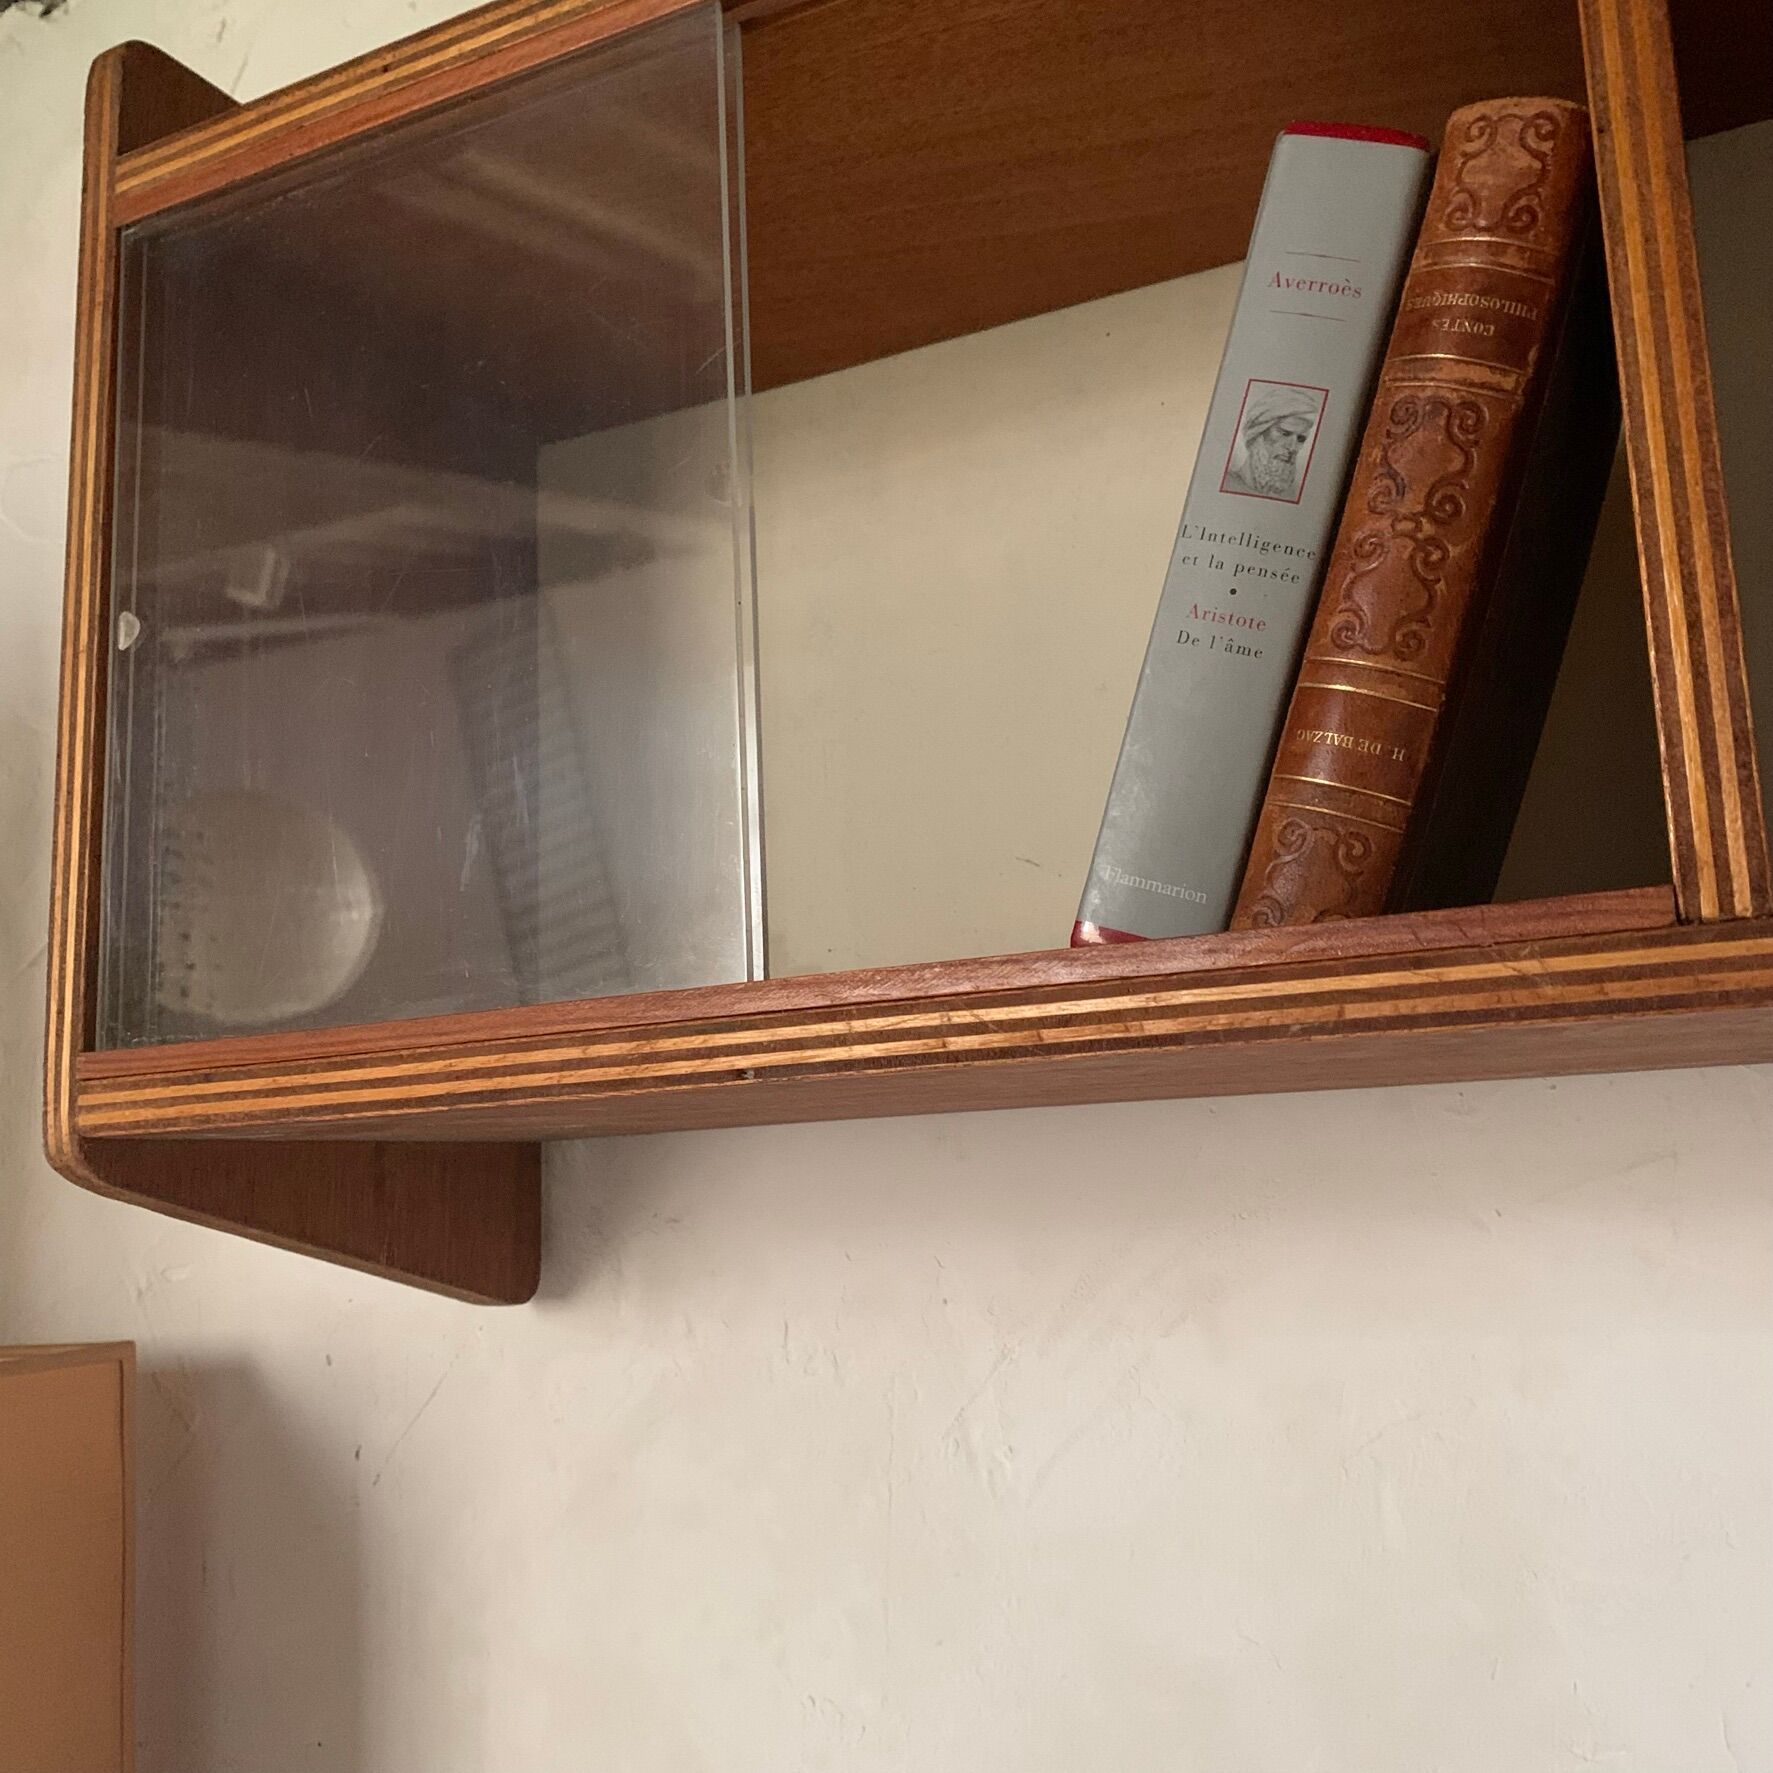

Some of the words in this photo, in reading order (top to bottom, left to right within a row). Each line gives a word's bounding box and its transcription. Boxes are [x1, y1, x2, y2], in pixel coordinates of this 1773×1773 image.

[1267, 271, 1362, 299] Averroès
[1406, 291, 1538, 320] PHILOSOPHIQUES
[1432, 318, 1495, 336] CONTES
[1181, 524, 1317, 561] L'Intelligence
[1182, 555, 1199, 567] et
[1209, 554, 1225, 571] la
[1233, 563, 1301, 585] pensée
[1187, 603, 1267, 632] Aristote
[1177, 630, 1200, 646] De
[1210, 635, 1264, 659] l'âme
[1297, 729, 1354, 748] BALZAC
[1359, 739, 1382, 755] DE
[1101, 865, 1207, 904] Flammarion
